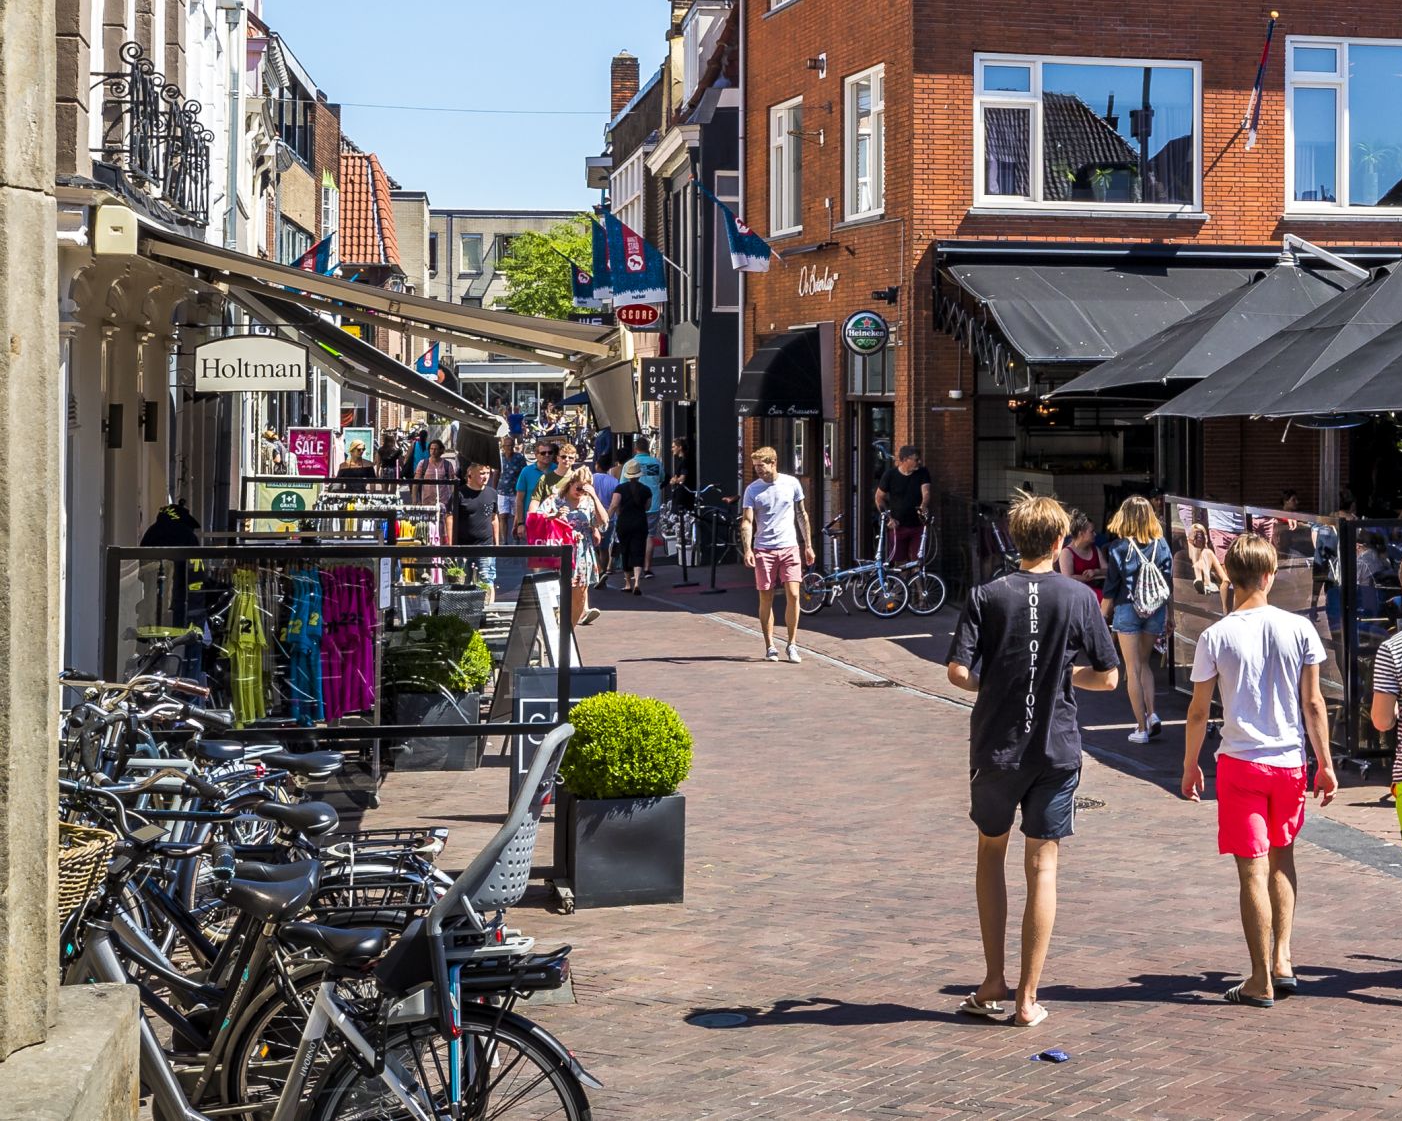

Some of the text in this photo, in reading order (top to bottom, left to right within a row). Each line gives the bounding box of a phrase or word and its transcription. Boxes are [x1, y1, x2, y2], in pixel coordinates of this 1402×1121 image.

[621, 309, 653, 320] SCORE
[848, 329, 885, 337] Heineken
[201, 358, 303, 378] Holtman
[294, 440, 324, 456] SALE
[281, 494, 297, 504] 1+1
[1028, 582, 1039, 634] MORE
[1024, 640, 1039, 733] OPTIONS
[300, 1041, 317, 1078] LIVORNO
